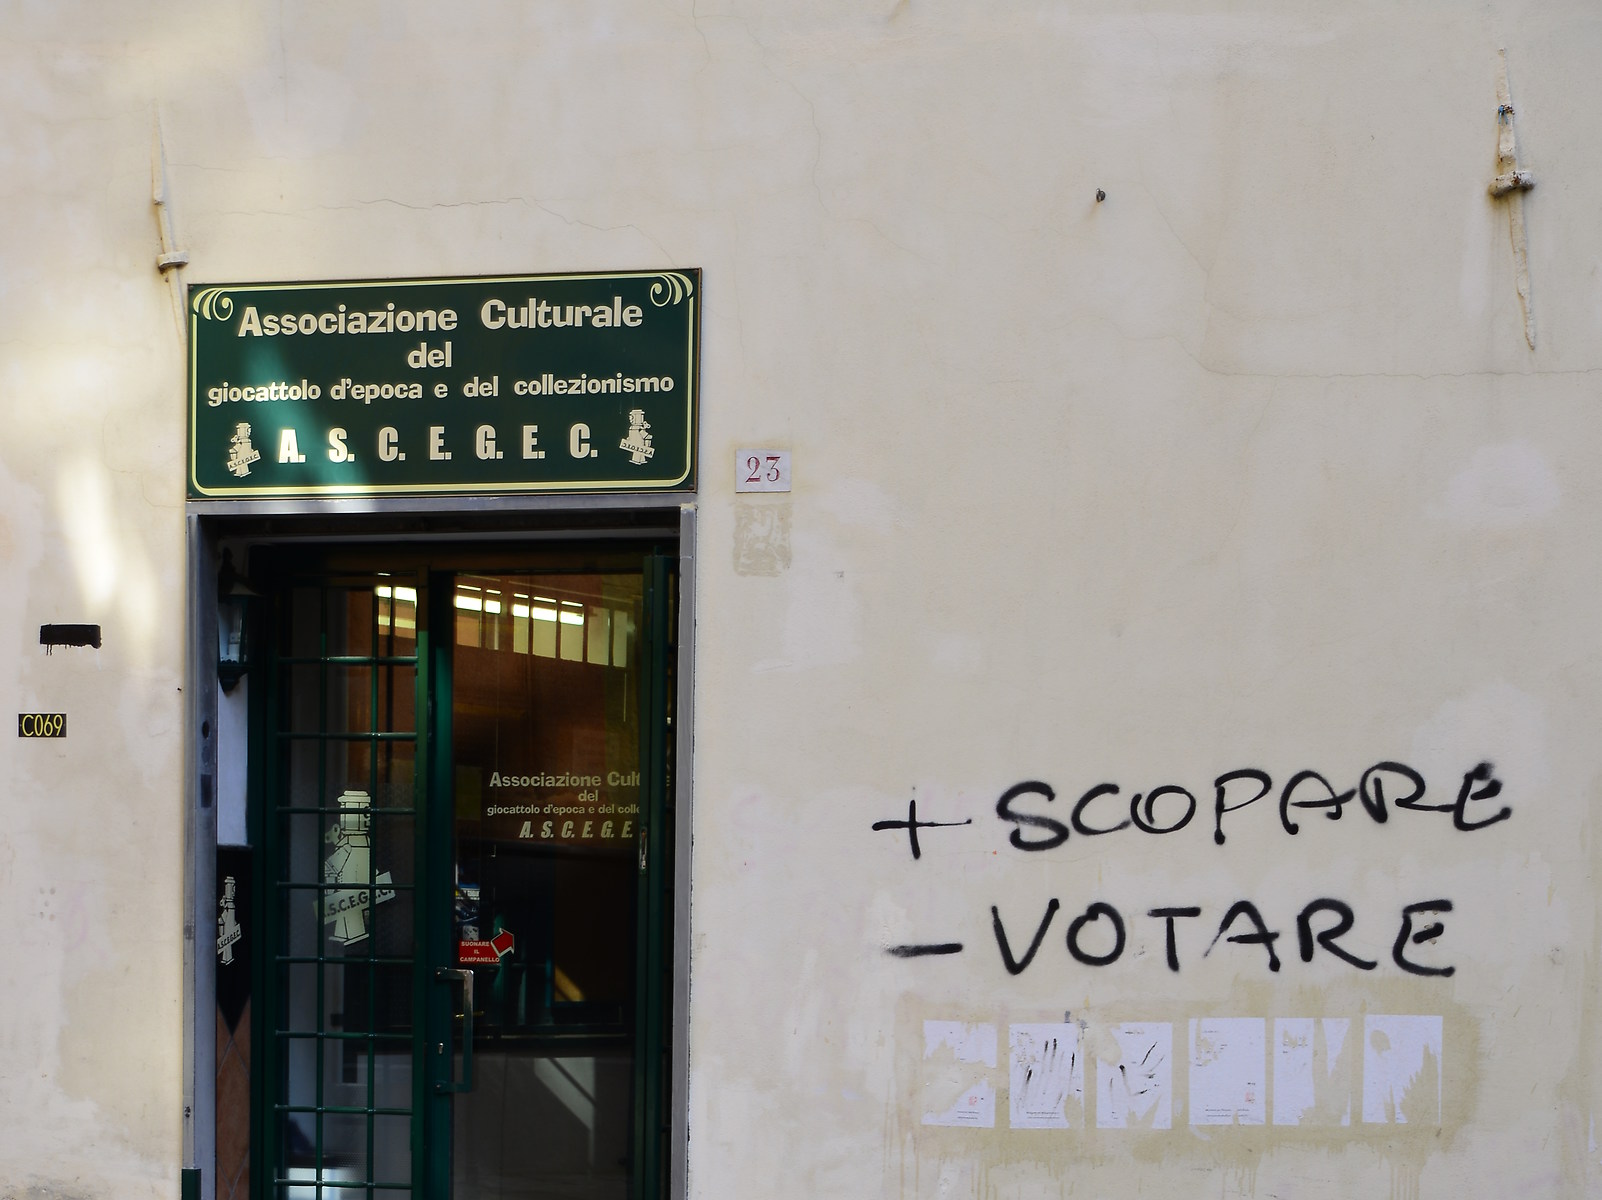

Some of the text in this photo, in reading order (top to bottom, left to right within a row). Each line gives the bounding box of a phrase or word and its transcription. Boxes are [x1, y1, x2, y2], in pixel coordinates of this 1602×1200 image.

[238, 296, 643, 337] Associazione Culturale
[407, 341, 452, 368] del
[208, 372, 675, 407] giocattolo d'epoca e del collezionismo
[278, 423, 598, 463] A. S. C. E. G. E. C.
[744, 455, 781, 484] 23
[21, 714, 64, 737] C069
[489, 771, 602, 787] Associazione
[487, 805, 540, 816] giocattolo
[543, 804, 586, 815] d'epoca
[598, 804, 615, 814] del
[578, 790, 599, 802] del
[997, 761, 1512, 852] SCOPARE
[519, 821, 633, 838] A. S. C. E. G. E.
[991, 898, 1456, 977] VOTARE
